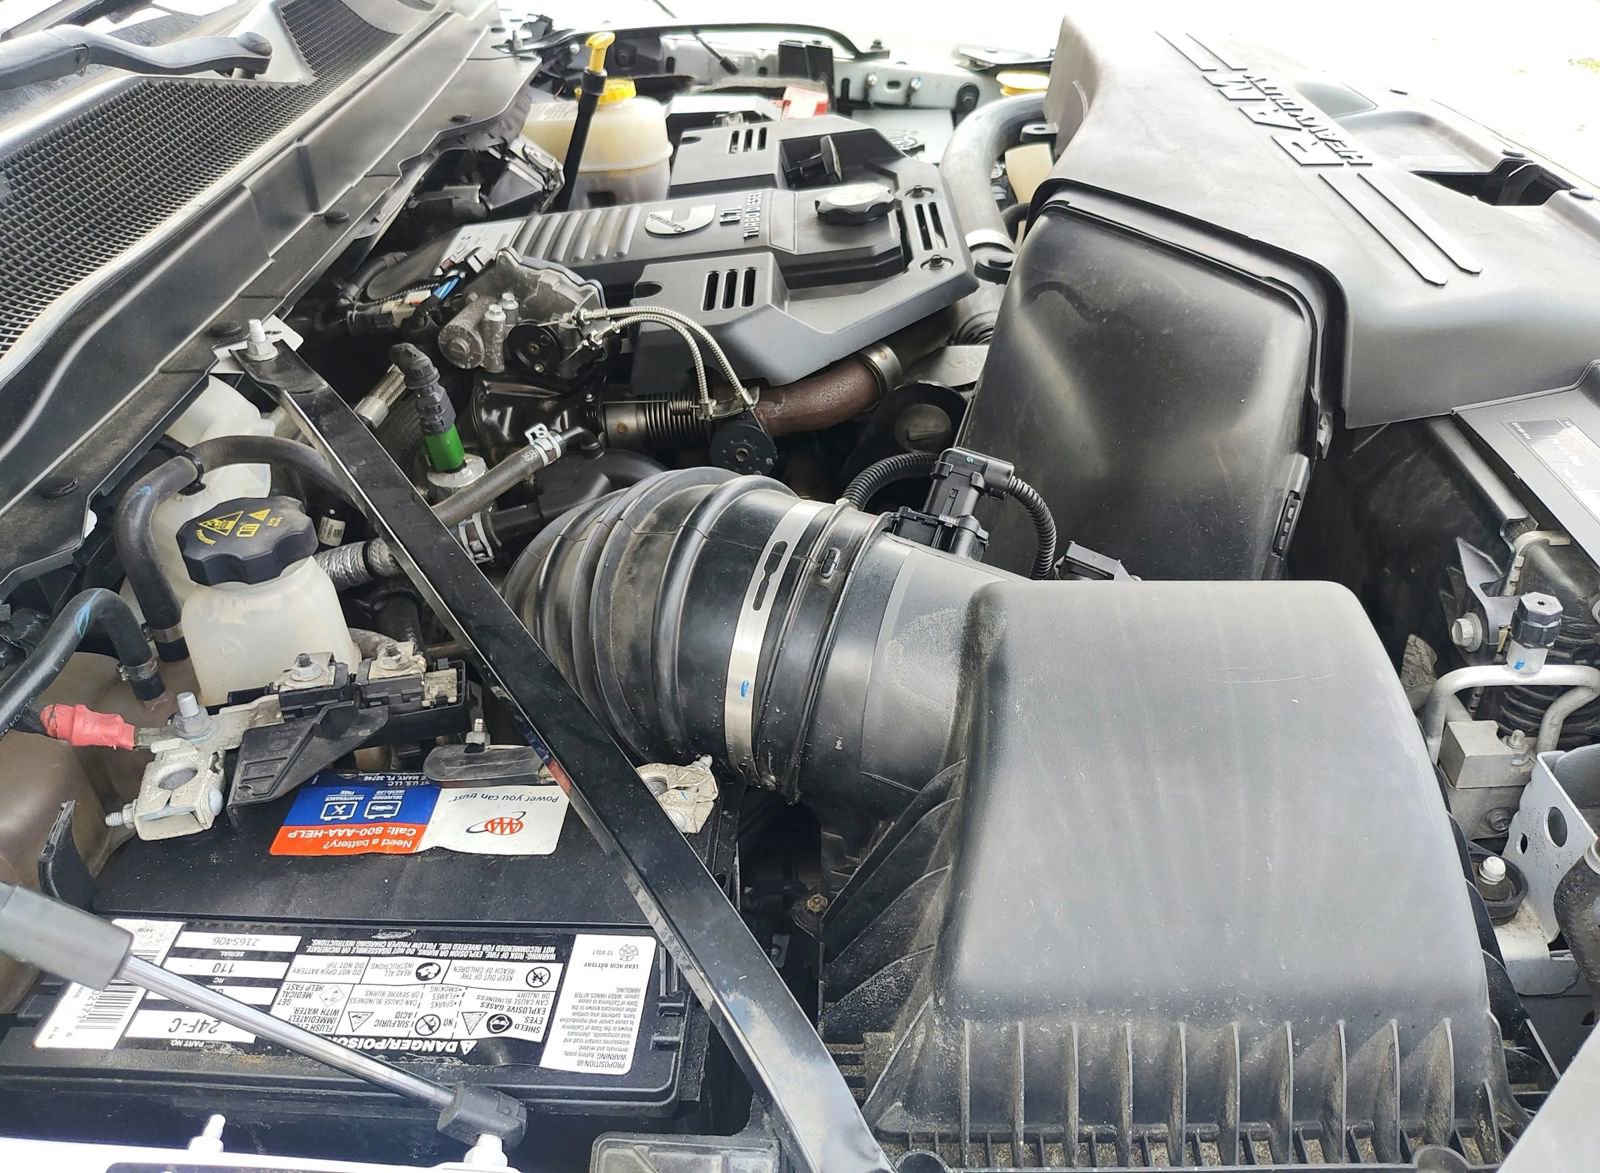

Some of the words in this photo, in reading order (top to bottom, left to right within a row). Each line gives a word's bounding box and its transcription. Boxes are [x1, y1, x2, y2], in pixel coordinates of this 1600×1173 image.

[1241, 74, 1305, 113] DUTY
[1201, 74, 1345, 167] RAM
[1286, 111, 1374, 167] HEAVY
[743, 211, 761, 240] TURBO
[488, 817, 521, 835] AAA
[287, 826, 384, 838] 800-AAA-HELP
[387, 827, 416, 836] Call:
[322, 839, 370, 849] battery?
[382, 839, 412, 848] Need
[212, 936, 260, 947] 2165406
[451, 943, 482, 951] INVERTED
[495, 944, 542, 953] RECOMMENDED
[449, 950, 484, 958] EXPLOSION
[212, 962, 235, 974] 110
[285, 983, 305, 991] FAST.
[305, 984, 325, 992] HELP
[282, 991, 313, 999] MEDICAL
[476, 995, 512, 1004] BLINDNESS
[277, 998, 292, 1006] GET
[349, 997, 383, 1005] BLINDNESS
[384, 998, 405, 1006] CAUSE
[430, 1000, 454, 1008] SPARKS
[514, 998, 534, 1006] CAUSE
[293, 1007, 319, 1015] WATER.
[480, 1002, 504, 1011] GASES
[506, 1006, 546, 1015] EXPLOSIVE
[320, 1008, 340, 1016] WITH
[395, 1011, 413, 1019] ACID
[288, 1015, 337, 1024] IMMEDIATELY
[374, 1019, 409, 1028] SULFURIC
[443, 1018, 453, 1026] NO
[168, 1018, 221, 1034] 24F-C
[310, 1024, 334, 1033] FLUSH
[514, 1023, 541, 1033] SHIELD
[585, 1060, 625, 1069] PROPOSITION
